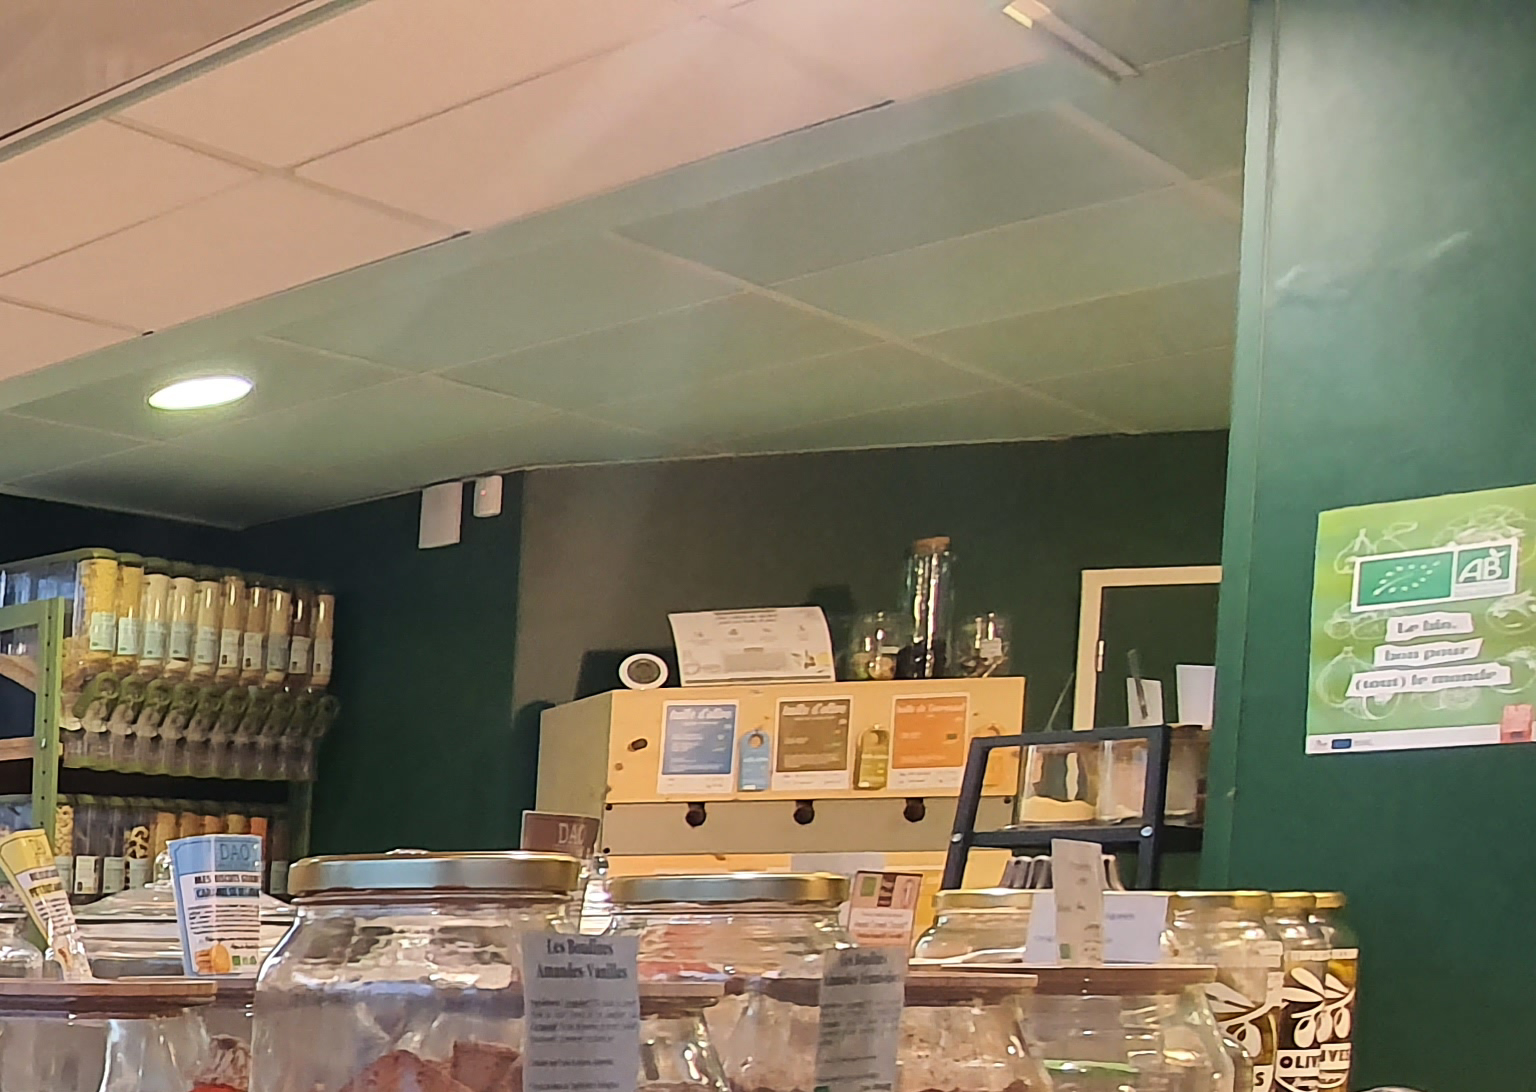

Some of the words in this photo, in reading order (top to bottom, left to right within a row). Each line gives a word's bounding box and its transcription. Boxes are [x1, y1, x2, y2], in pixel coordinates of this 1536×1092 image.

[1457, 555, 1503, 583] AB
[1397, 621, 1419, 634] Le
[1385, 648, 1418, 662] bon
[1423, 645, 1470, 662] pour
[1431, 669, 1498, 685] monde
